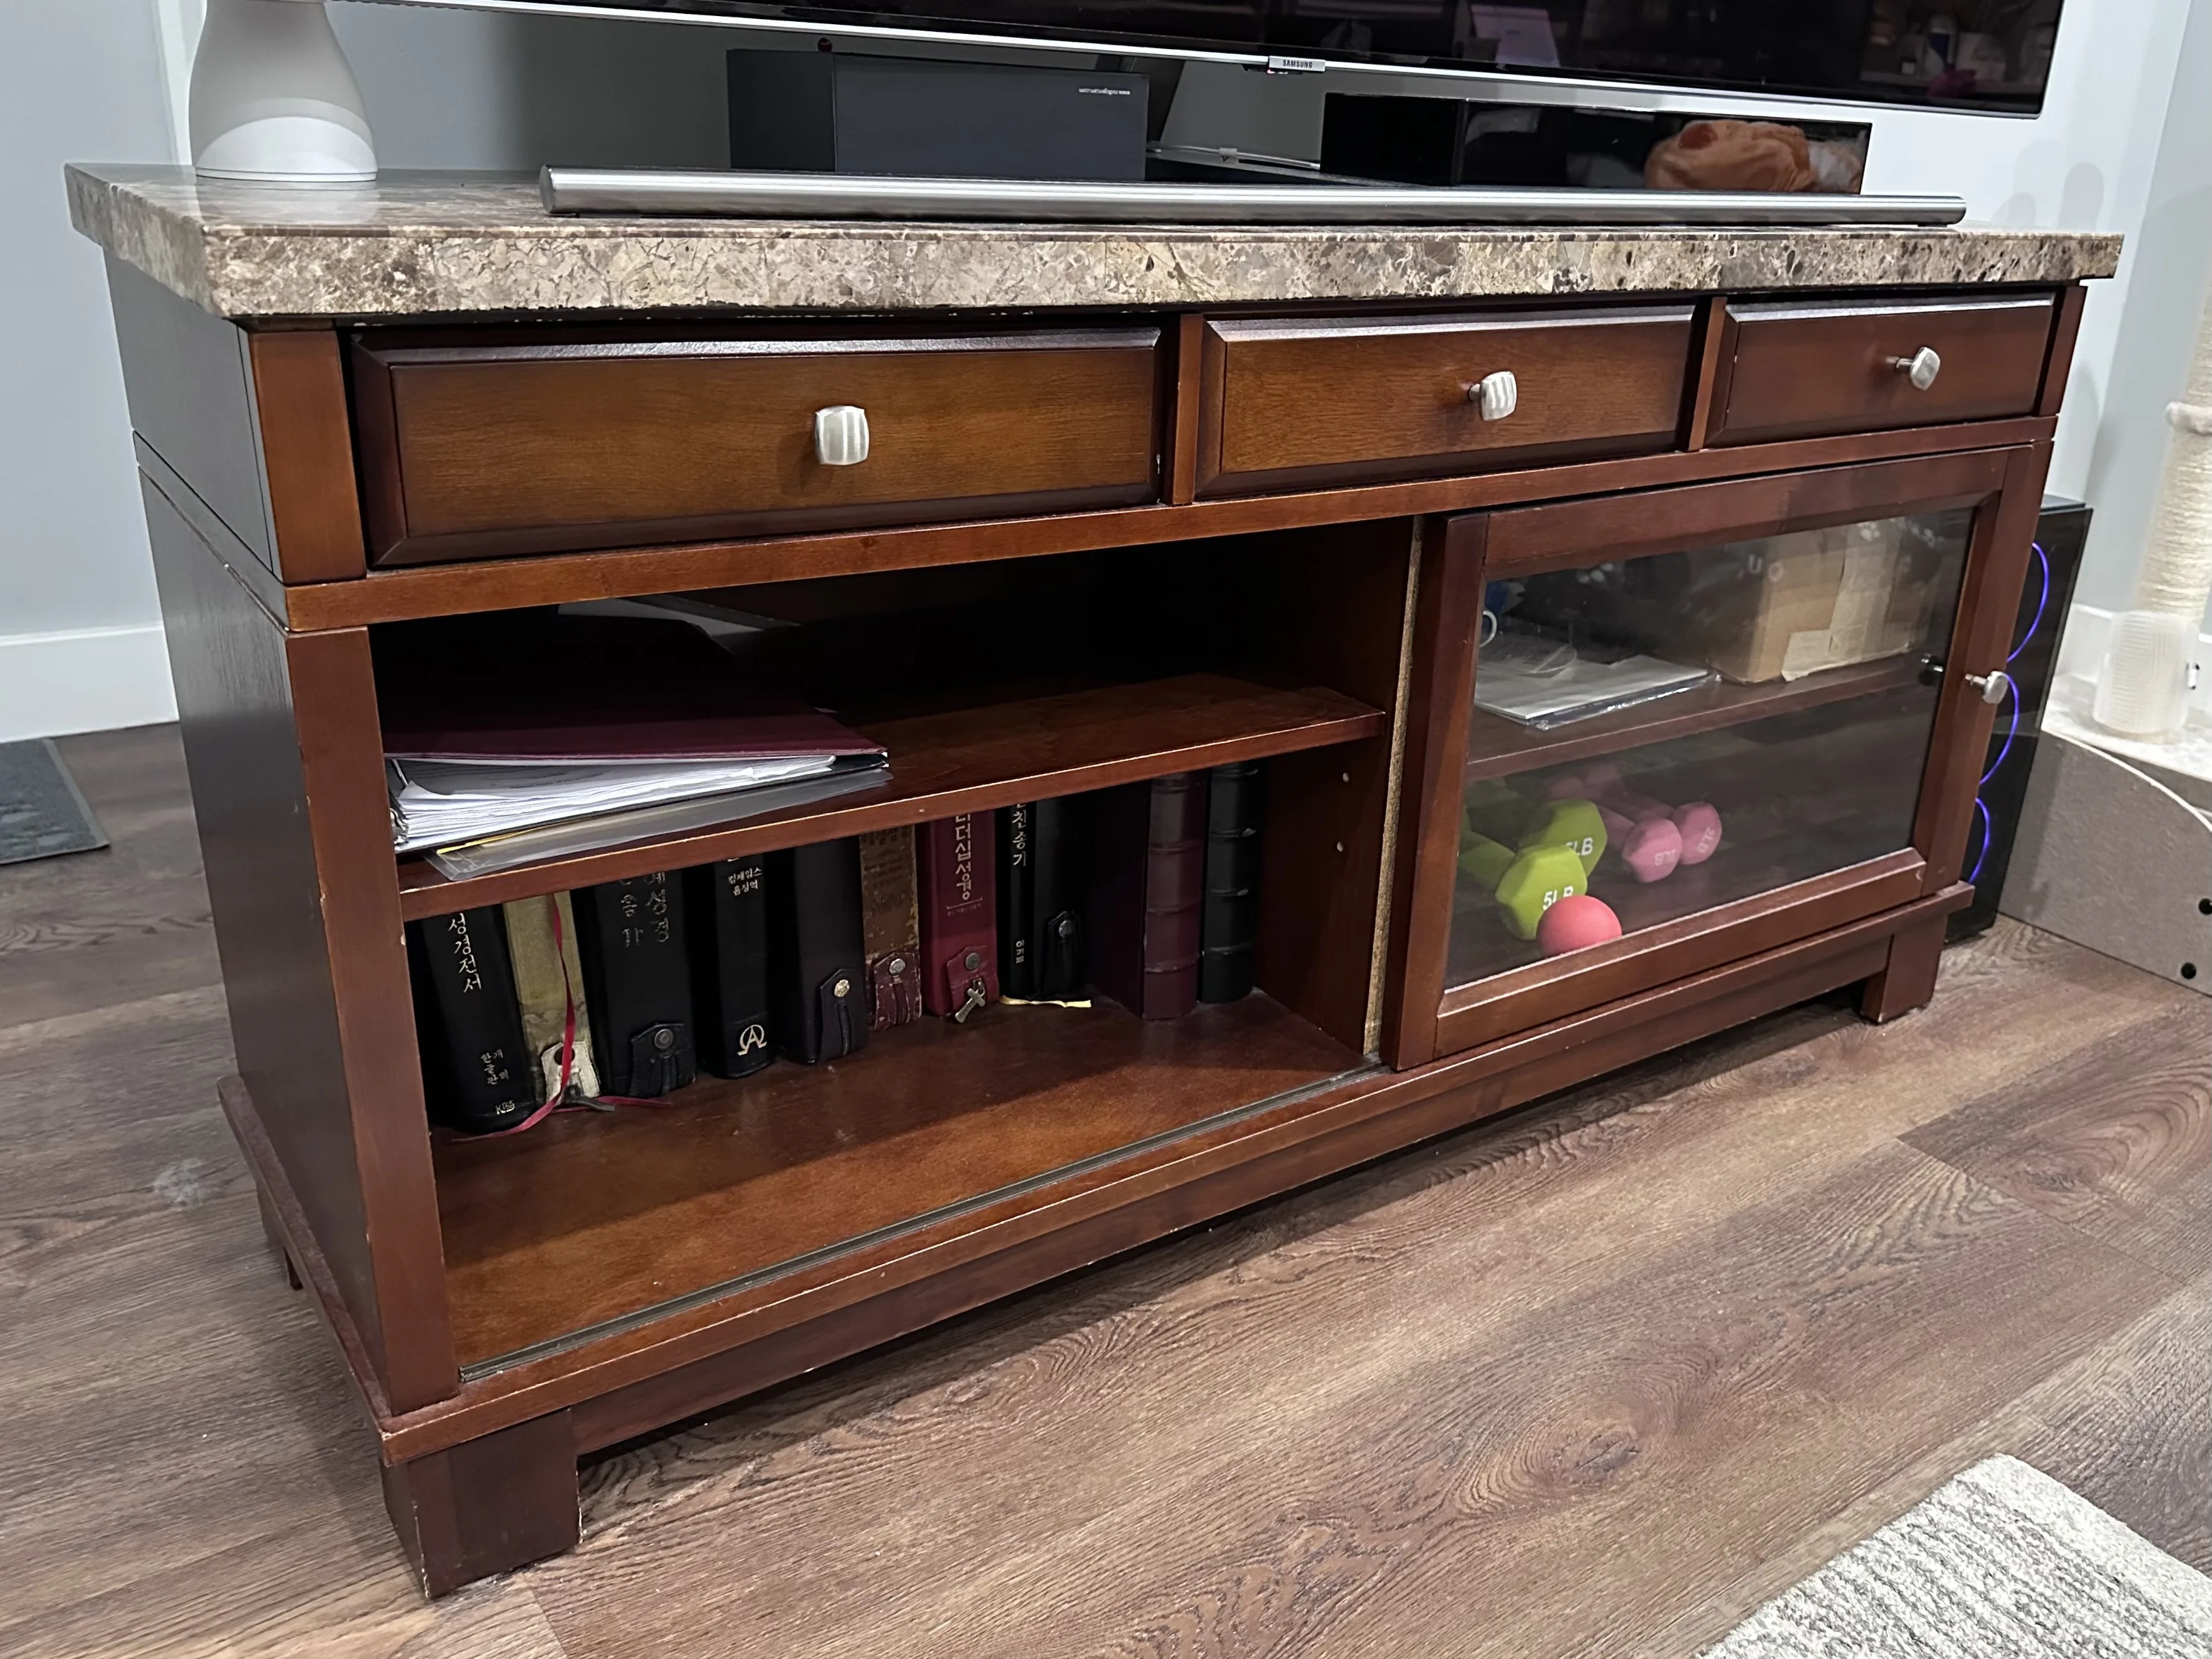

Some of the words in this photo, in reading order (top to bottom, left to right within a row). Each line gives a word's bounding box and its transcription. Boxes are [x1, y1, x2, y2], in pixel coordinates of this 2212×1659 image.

[1282, 59, 1313, 69] SAMSUNG
[728, 867, 763, 885] 킹제임스
[732, 879, 758, 896] 흠정역
[619, 880, 644, 948] 송가
[448, 913, 482, 993] 성경전서
